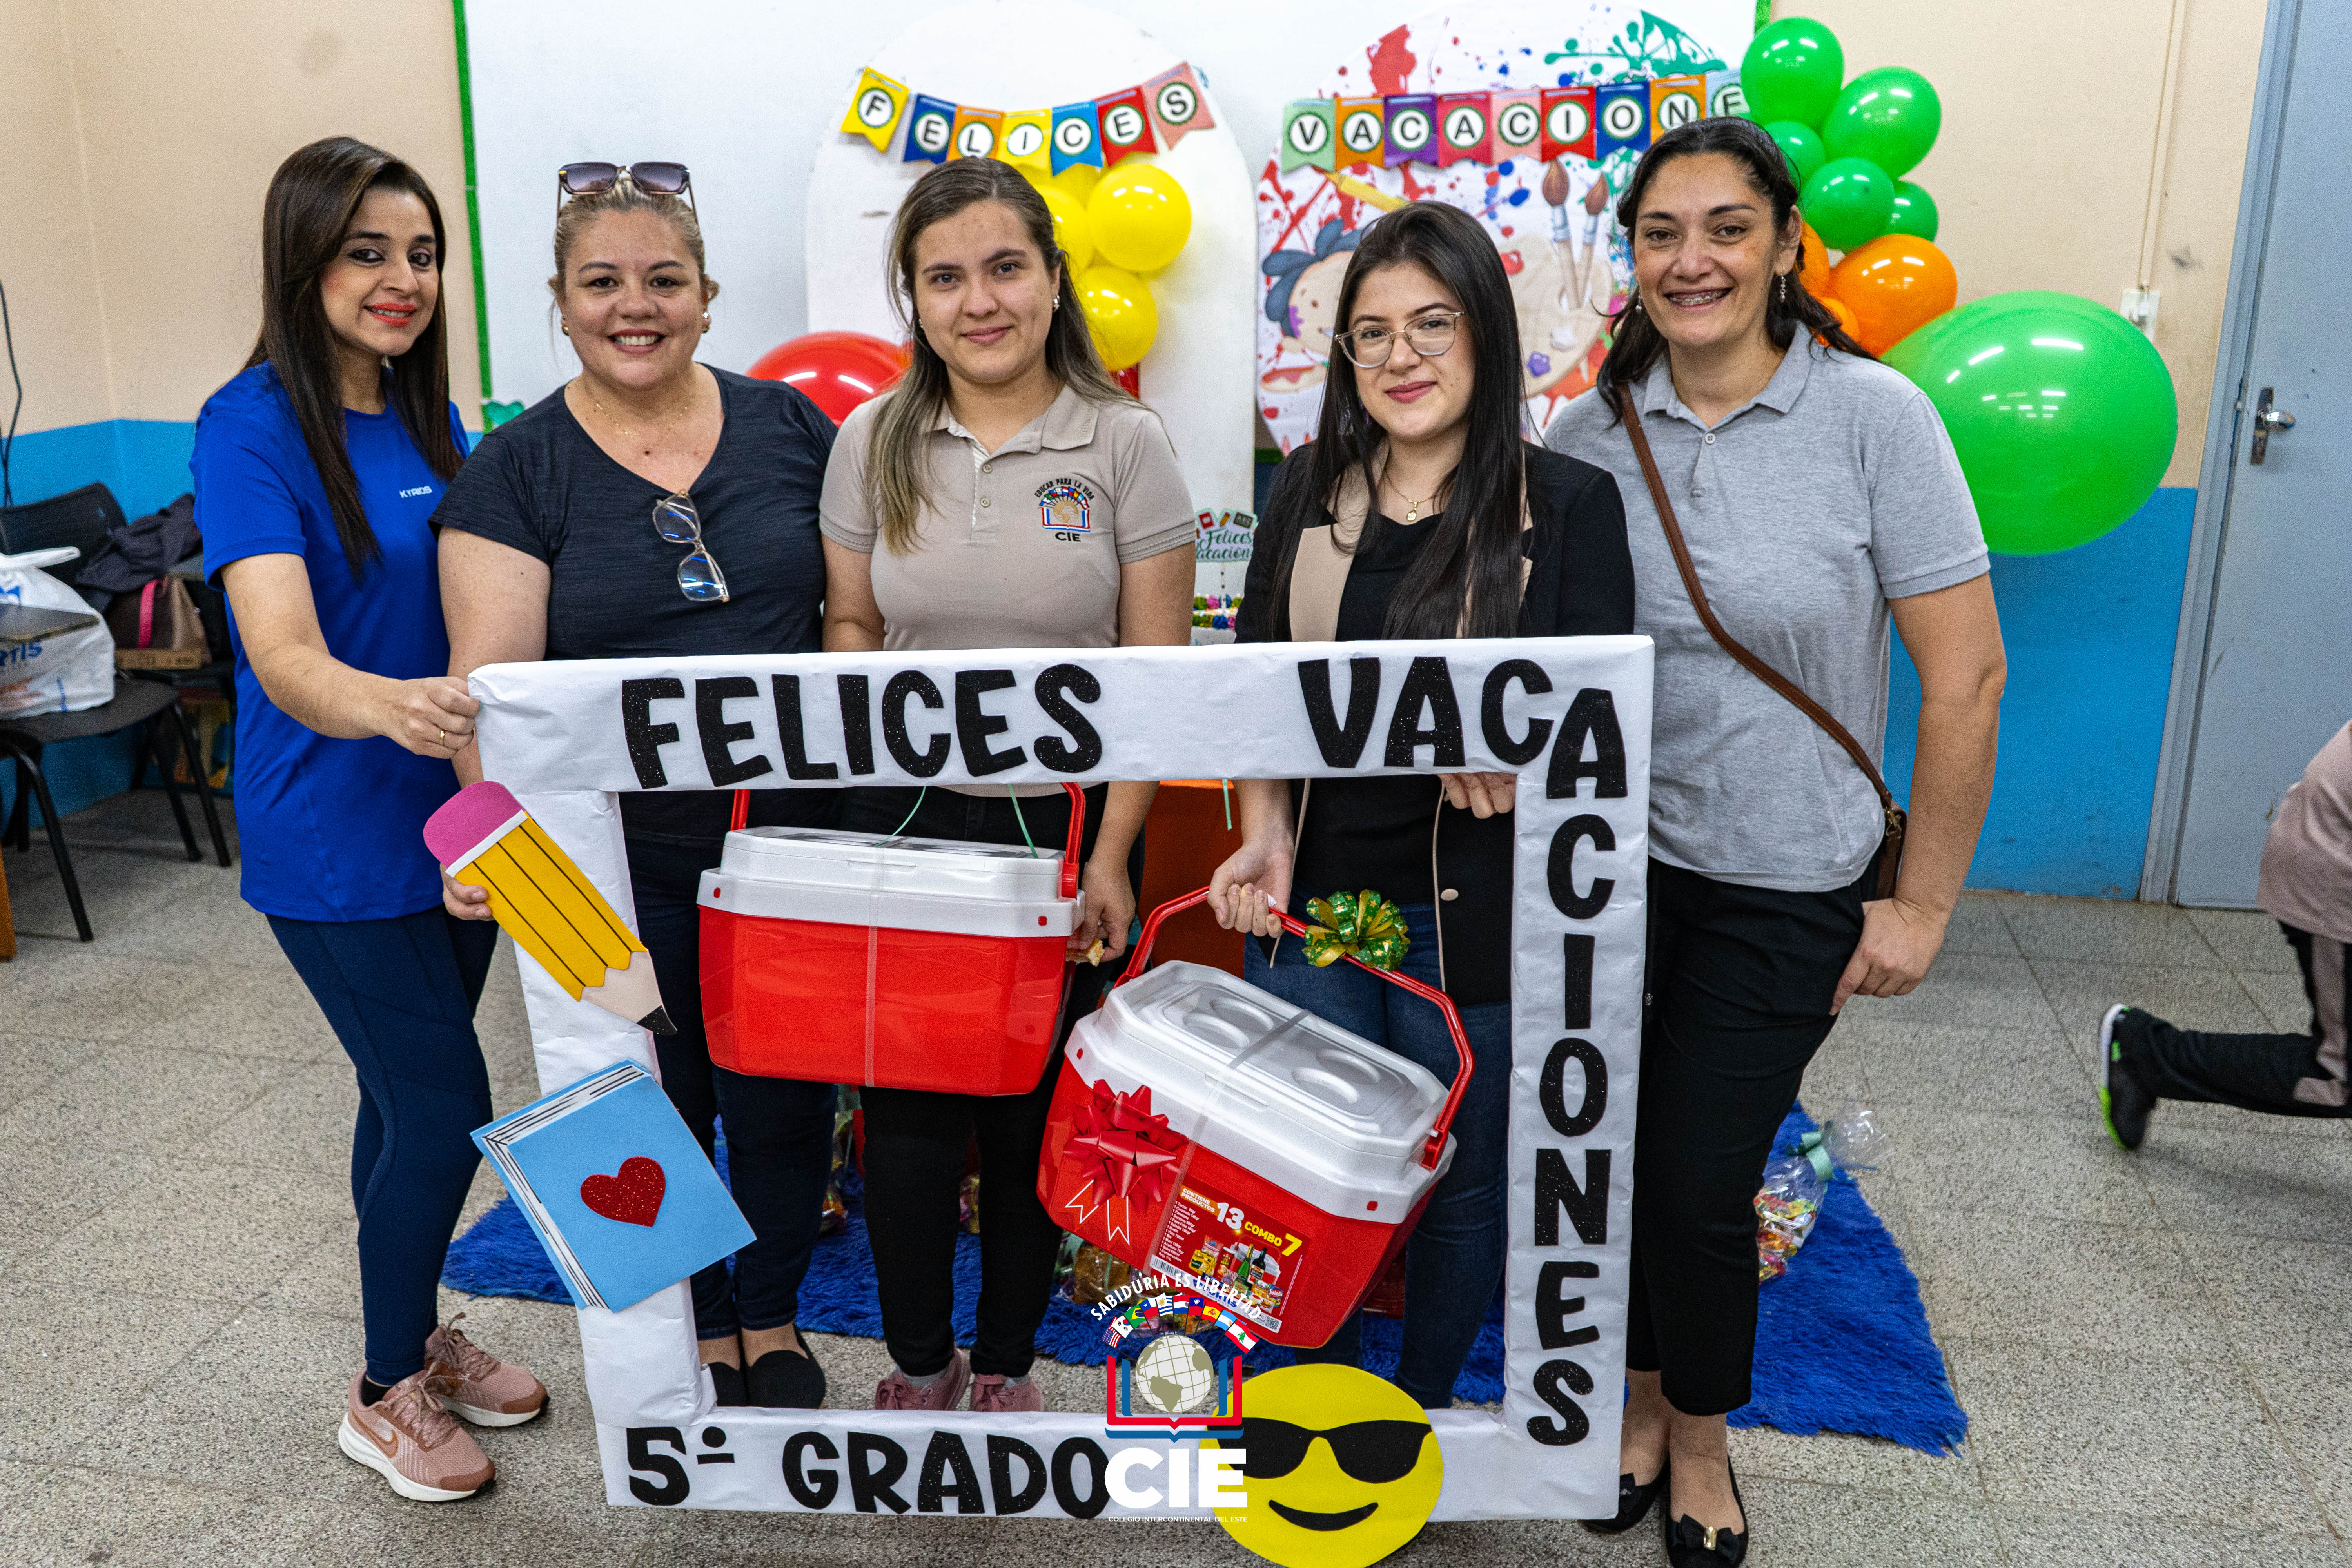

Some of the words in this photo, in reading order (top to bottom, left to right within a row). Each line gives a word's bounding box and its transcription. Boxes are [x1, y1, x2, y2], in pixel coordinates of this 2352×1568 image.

[866, 90, 1188, 154] FELICES
[1300, 92, 1742, 146] VACACIONE
[1034, 481, 1054, 497] EDUCAR
[1074, 480, 1082, 489] LA
[1083, 486, 1095, 501] VIDA
[1055, 532, 1081, 542] CIE
[1205, 526, 1252, 550] Felices
[622, 664, 1102, 789] FELICES
[1181, 1192, 1215, 1212] PRODUCTOS
[1183, 1188, 1210, 1205] CONTIENE
[1217, 1202, 1244, 1230] 13
[1245, 1221, 1282, 1247] COMBO
[1282, 1234, 1302, 1256] 7
[782, 1431, 1111, 1520] GRADO
